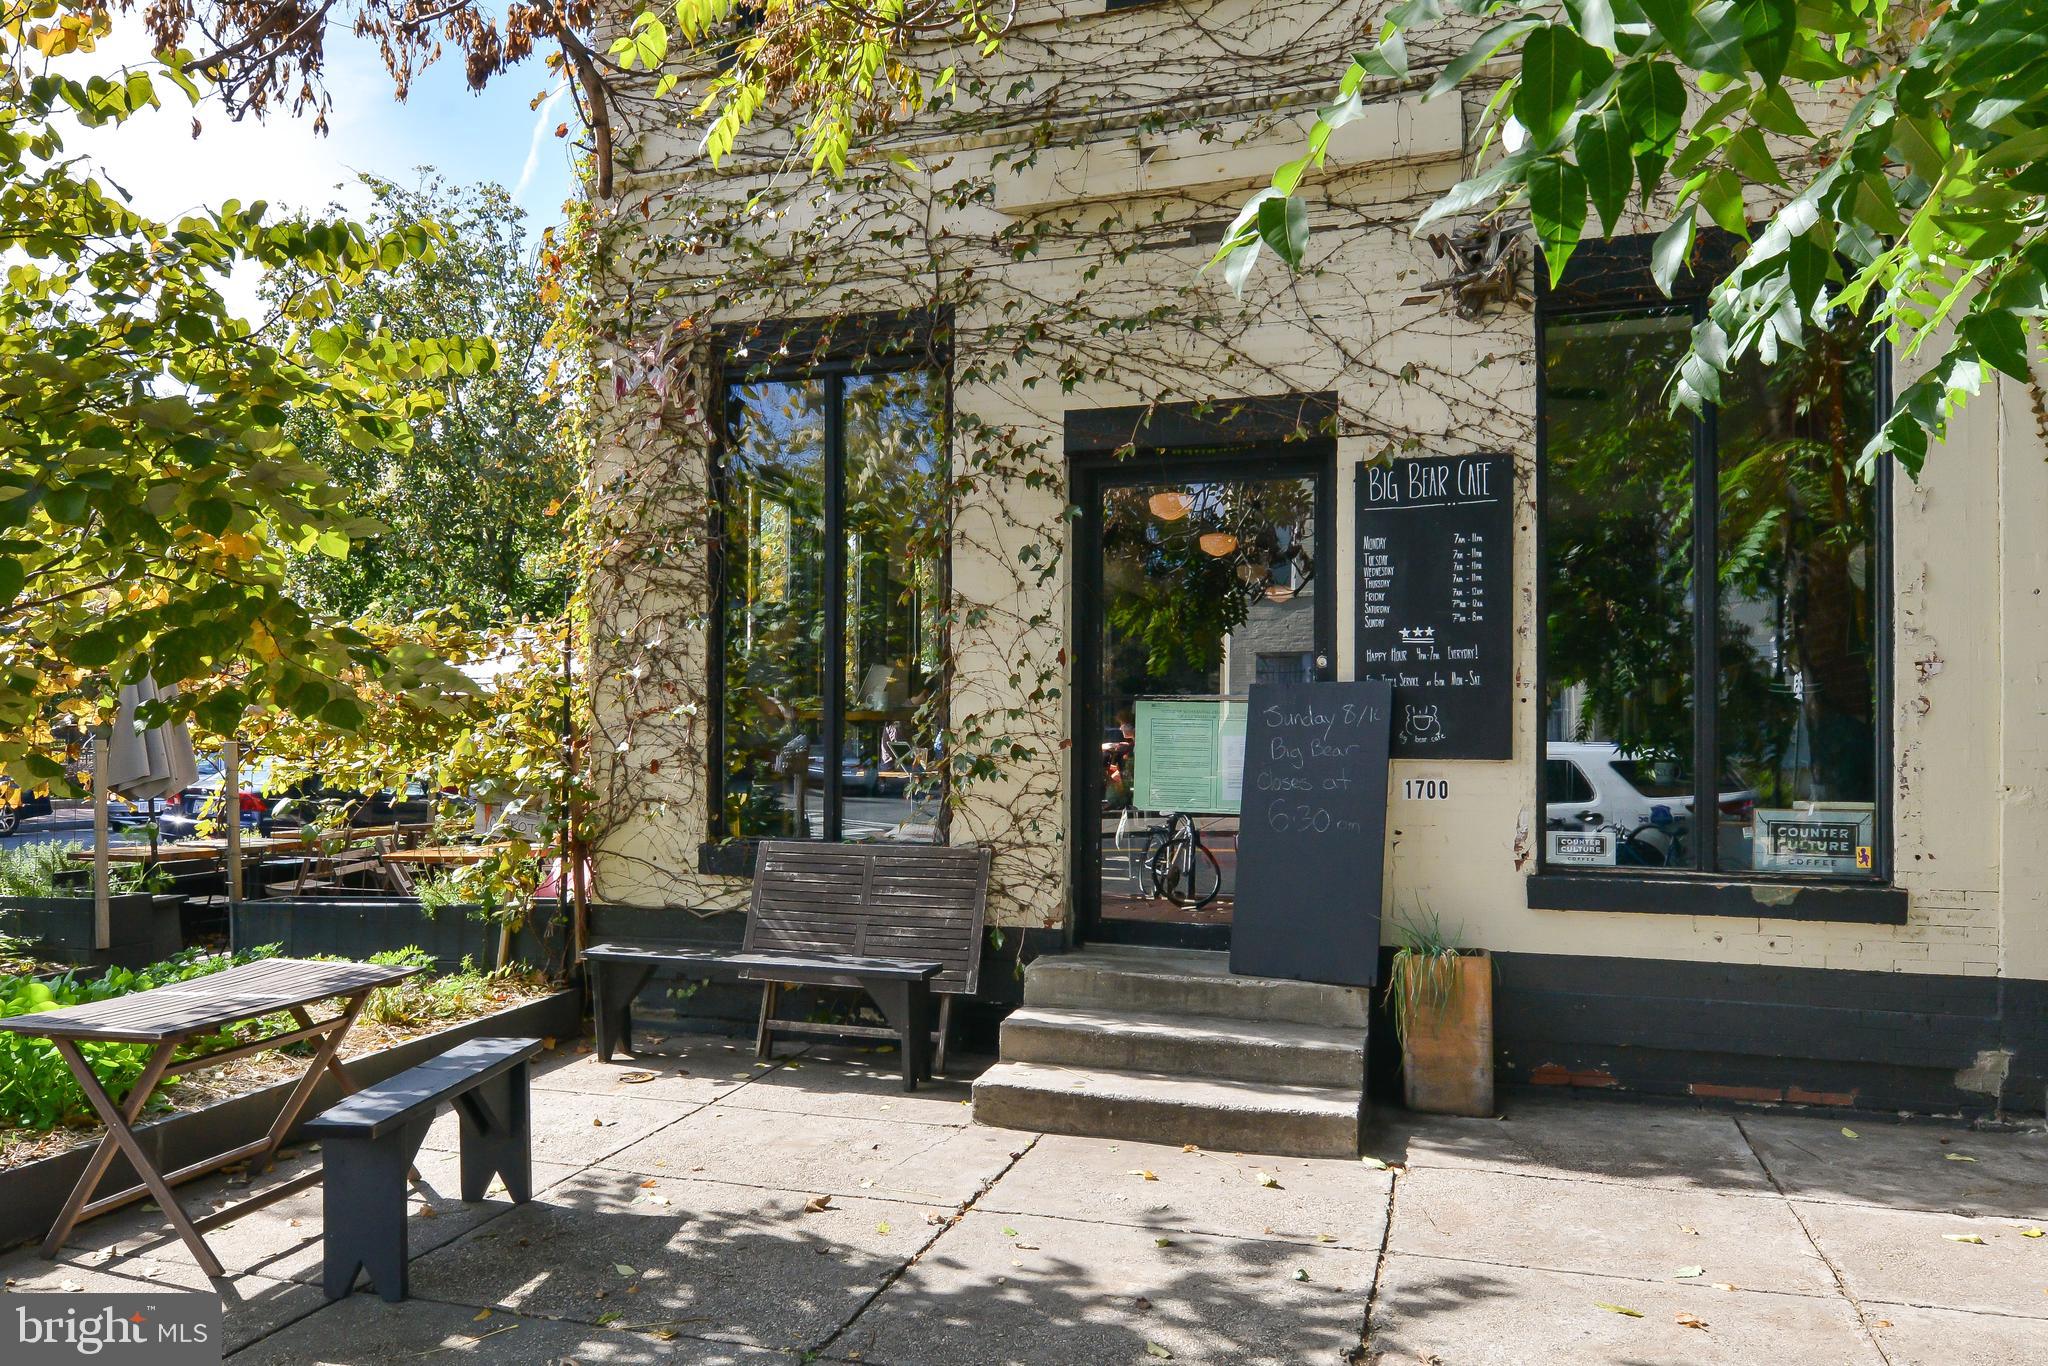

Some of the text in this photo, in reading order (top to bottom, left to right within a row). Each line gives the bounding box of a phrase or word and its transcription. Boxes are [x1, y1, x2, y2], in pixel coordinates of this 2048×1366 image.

[1369, 459, 1492, 502] BIG BEAR CAFE
[1363, 535, 1387, 550] MONDAY
[1363, 552, 1389, 567] TUESDAY
[1363, 566, 1394, 578] WEDNESDAY
[1364, 577, 1391, 589] THURSDAY
[1364, 591, 1386, 602] FRIDAY
[1364, 602, 1391, 614] SATURDAY
[1364, 615, 1386, 628] SUNDAY
[1366, 648, 1388, 662] HAPPY
[1391, 647, 1407, 662] HOUR
[1447, 643, 1479, 660] EVERYDAY!
[1399, 672, 1420, 687] SERVICE
[1263, 704, 1336, 741] Sunday
[1271, 736, 1304, 769] Big
[1311, 737, 1361, 758] Bear
[1256, 767, 1352, 791] Closes at
[1406, 780, 1448, 799] 1700
[1777, 827, 1849, 839] COUNTER
[1561, 838, 1601, 847] COUNTER
[1777, 840, 1849, 852] CULTURE
[1561, 846, 1601, 854] CULTURE
[1788, 858, 1837, 867] COFFEE
